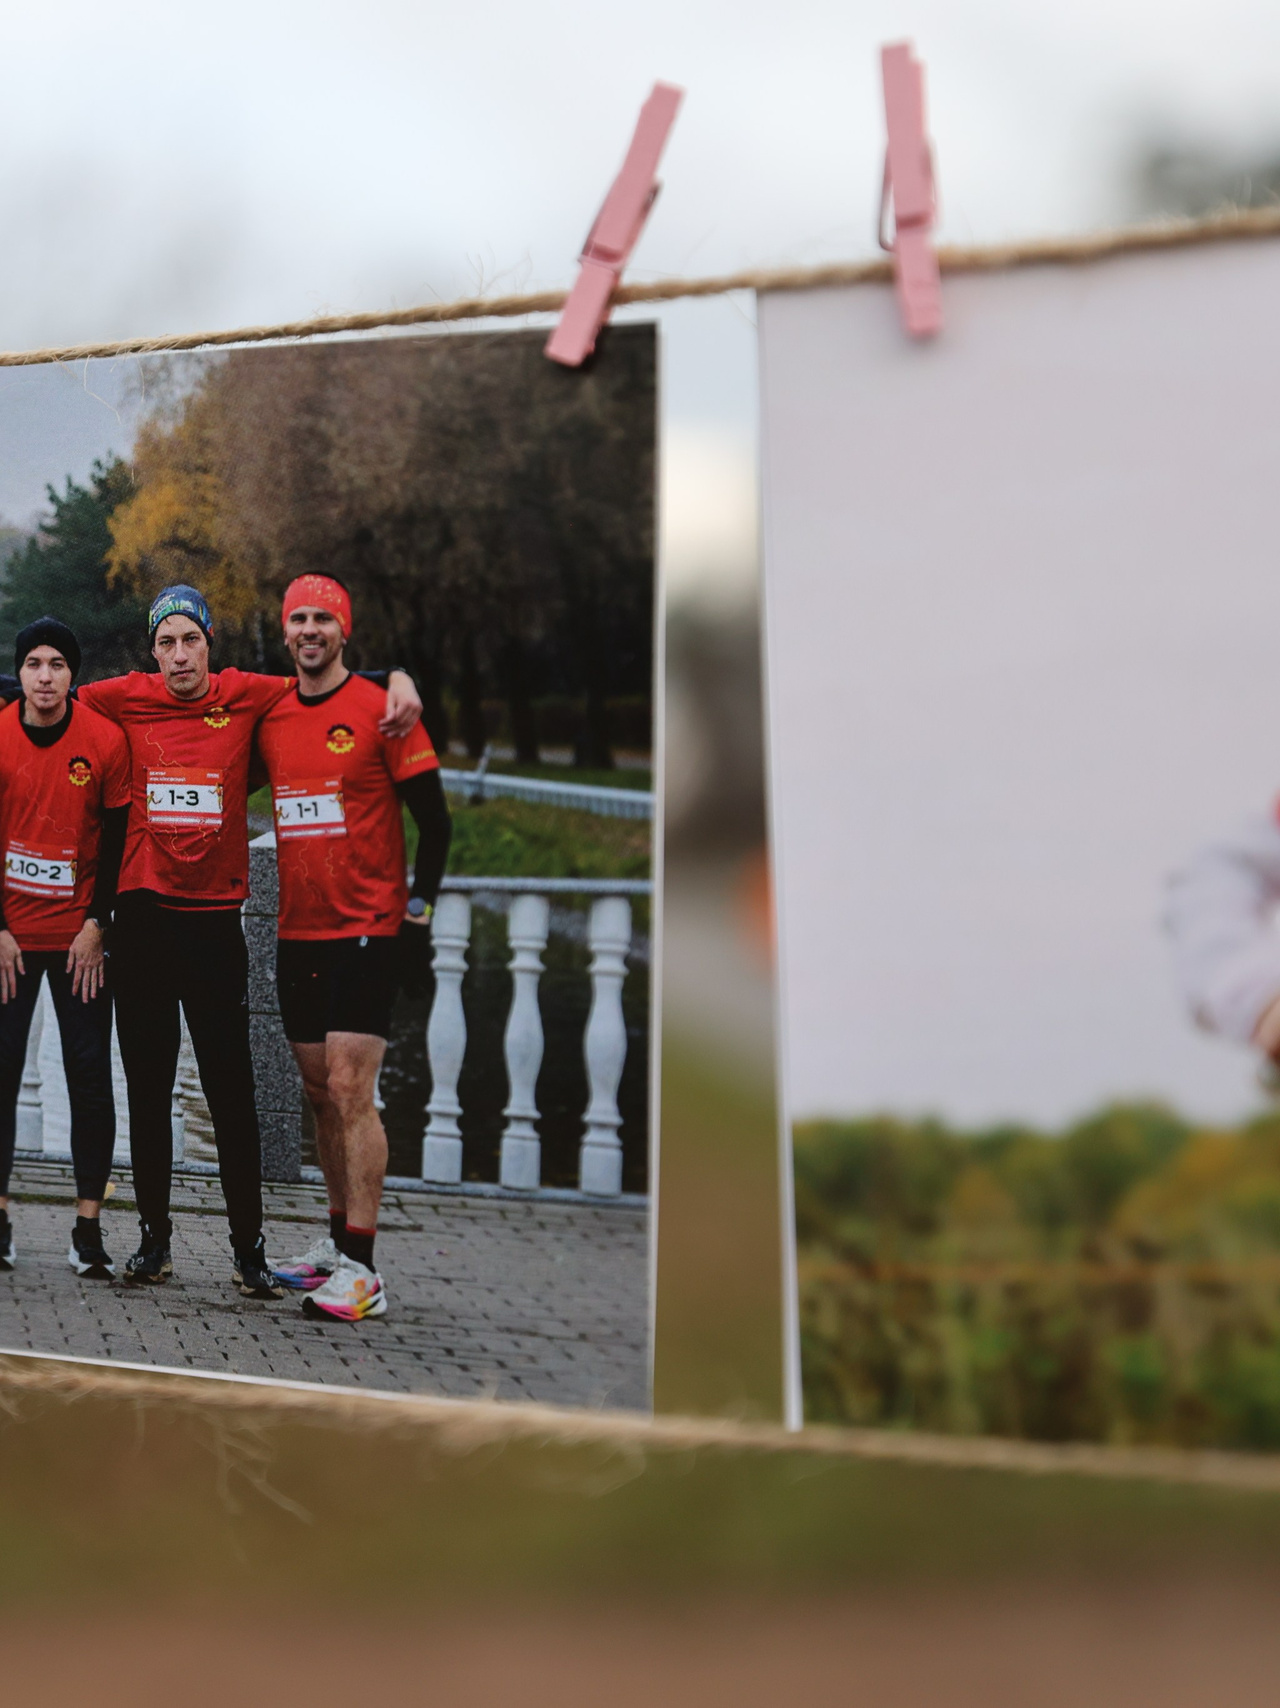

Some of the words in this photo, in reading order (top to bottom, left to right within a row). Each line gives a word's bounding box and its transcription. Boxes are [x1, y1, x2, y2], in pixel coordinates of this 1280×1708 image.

[168, 789, 200, 807] 1-3
[297, 801, 319, 819] 1-1
[20, 860, 62, 880] 10-2
